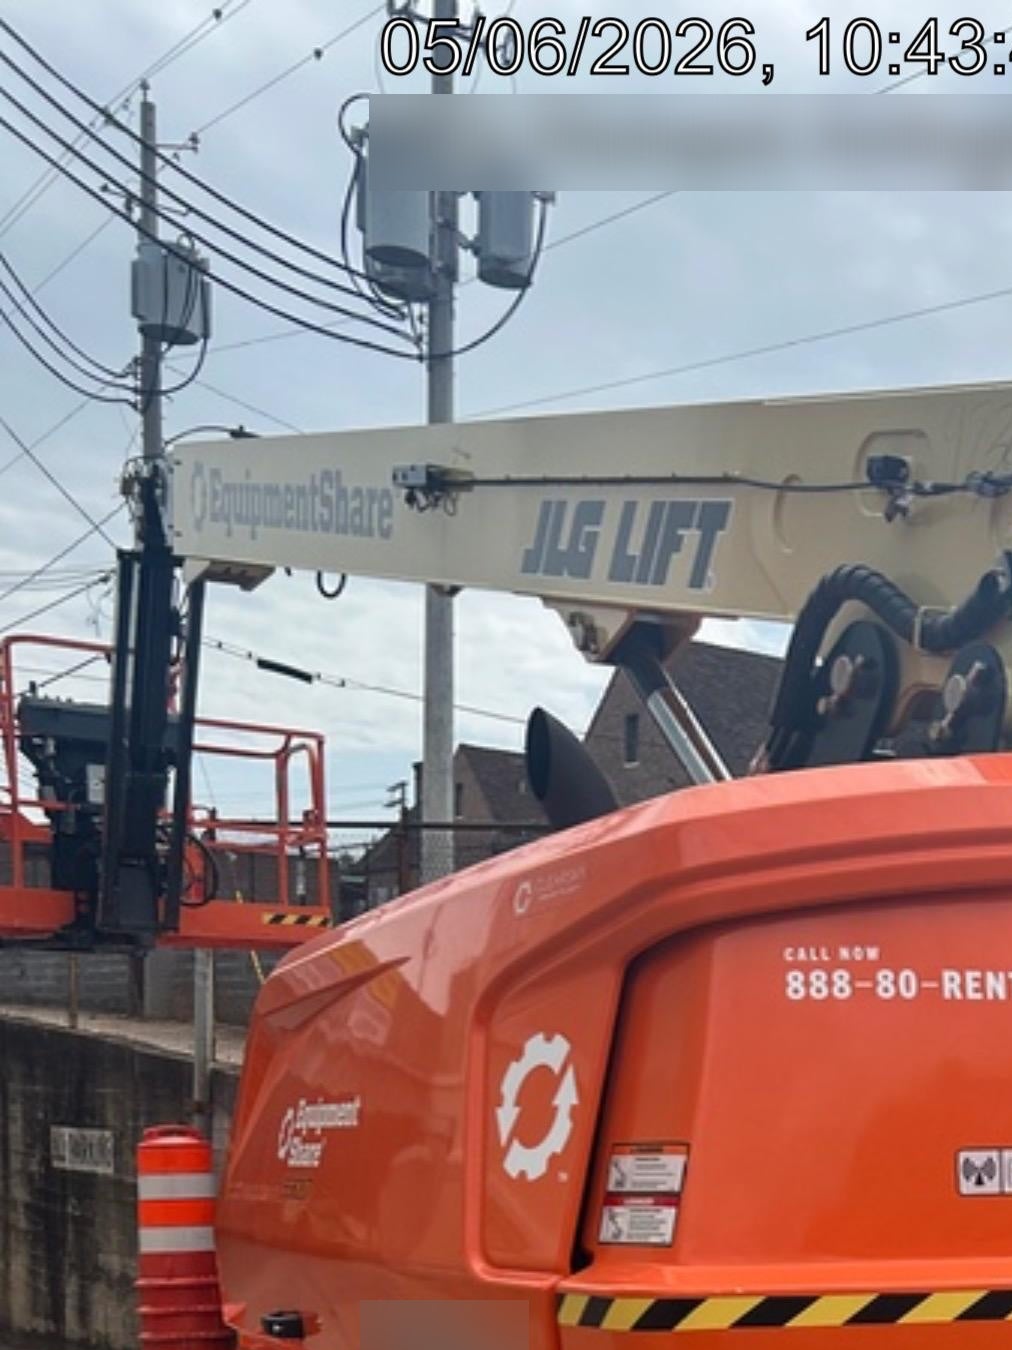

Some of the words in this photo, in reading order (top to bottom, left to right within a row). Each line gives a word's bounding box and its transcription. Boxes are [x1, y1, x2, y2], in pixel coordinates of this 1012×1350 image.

[208, 469, 394, 540] EquipmentShare
[520, 499, 605, 581] JLG
[607, 499, 733, 590] LIFT
[783, 947, 831, 961] CALL
[838, 946, 880, 961] NOW
